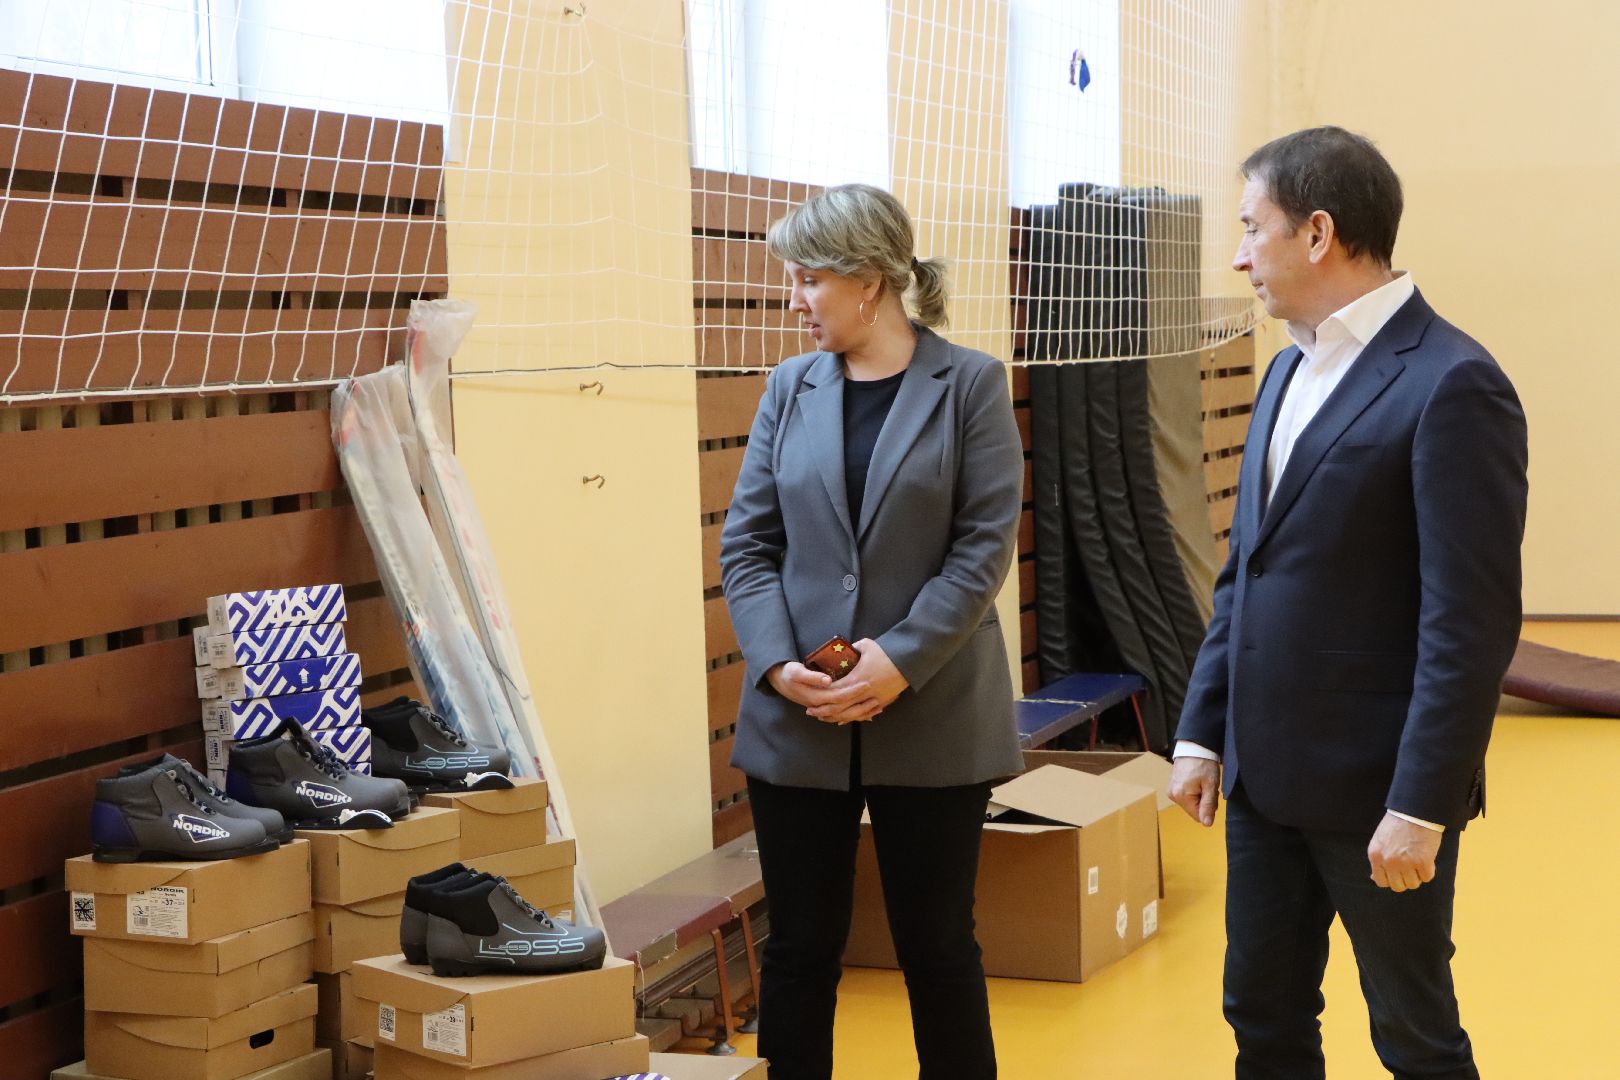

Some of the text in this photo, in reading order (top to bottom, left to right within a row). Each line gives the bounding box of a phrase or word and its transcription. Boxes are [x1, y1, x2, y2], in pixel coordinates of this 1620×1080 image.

[295, 785, 353, 804] NORDIK
[172, 819, 230, 838] NORDIK
[479, 936, 586, 956] LOSS
